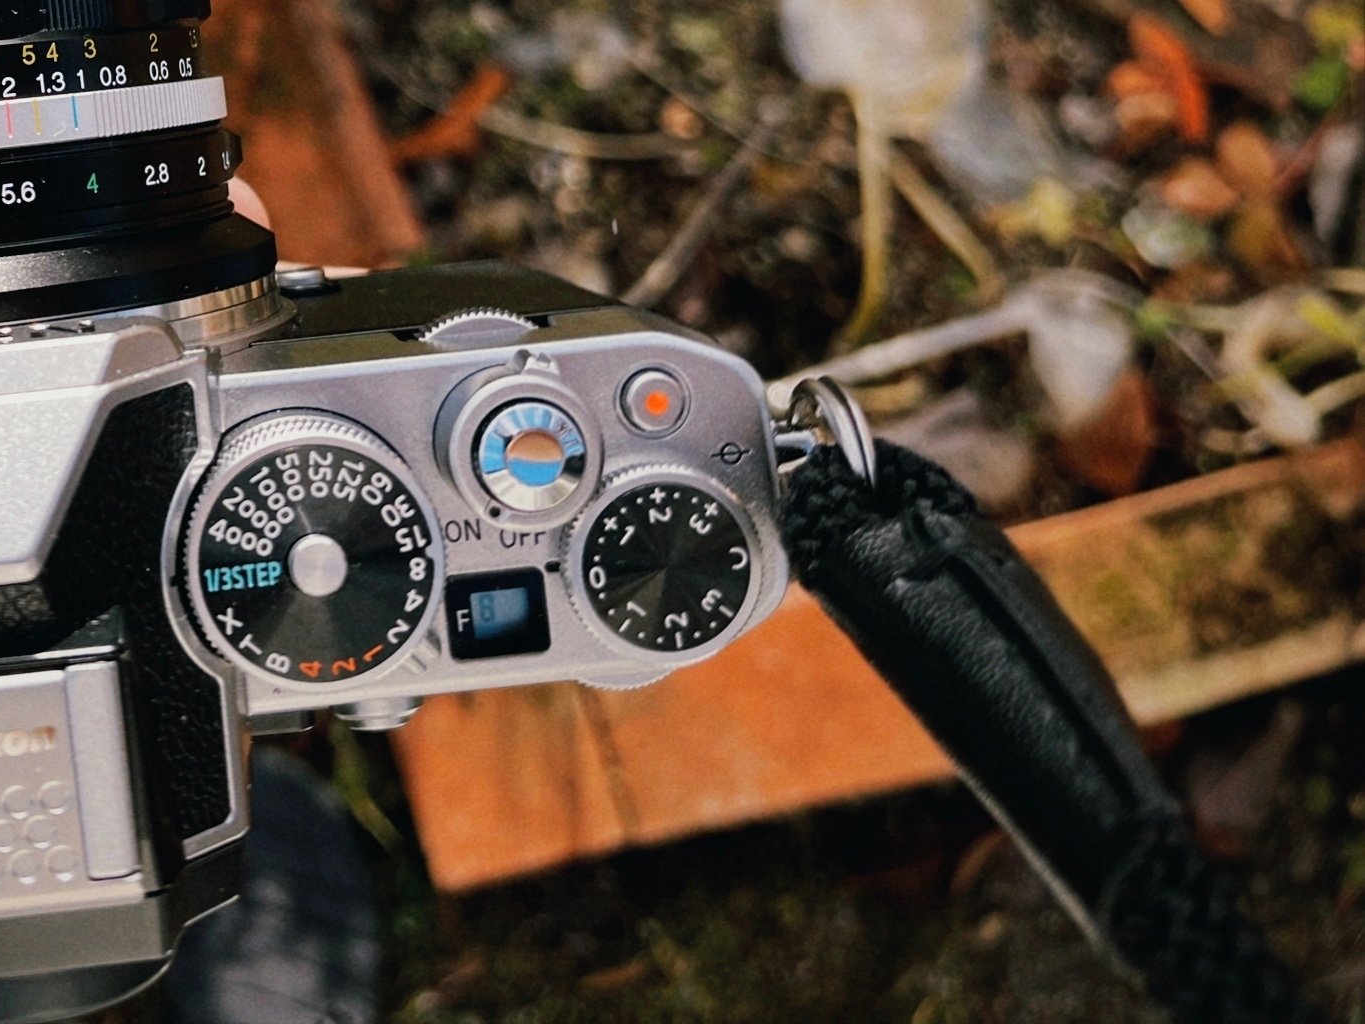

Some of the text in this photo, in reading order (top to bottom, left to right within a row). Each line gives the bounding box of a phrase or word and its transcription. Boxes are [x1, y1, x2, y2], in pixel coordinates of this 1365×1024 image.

[22, 44, 36, 66] 5
[46, 42, 59, 63] 4
[84, 38, 97, 59] 3
[149, 32, 159, 53] 2
[1, 77, 17, 98] 2
[36, 71, 66, 94] 1.3
[76, 69, 85, 90] 1
[99, 64, 127, 87] 0.8
[149, 60, 169, 81] 0.6
[178, 57, 193, 78] 0.5
[1, 180, 36, 205] 5.6
[86, 172, 99, 194] 4
[144, 162, 170, 186] 2.8
[196, 156, 207, 176] 2
[275, 452, 305, 502] 500
[307, 450, 334, 499] 250
[332, 459, 366, 503] 125
[361, 471, 393, 506] 60
[249, 466, 295, 524] 1000
[222, 486, 282, 539] 2000
[381, 494, 416, 528] 30
[208, 518, 273, 557] 4000
[394, 525, 428, 553] 15
[445, 518, 482, 543] ON
[409, 556, 427, 581] 8
[729, 546, 748, 570] C
[588, 566, 606, 590] 0
[404, 588, 425, 613] 4
[216, 607, 244, 635] X
[387, 618, 411, 645] 2
[456, 609, 470, 632] F
[239, 634, 263, 656] T
[362, 643, 384, 663] 1
[265, 652, 291, 674] B
[299, 659, 323, 678] 4
[331, 657, 357, 676] 2
